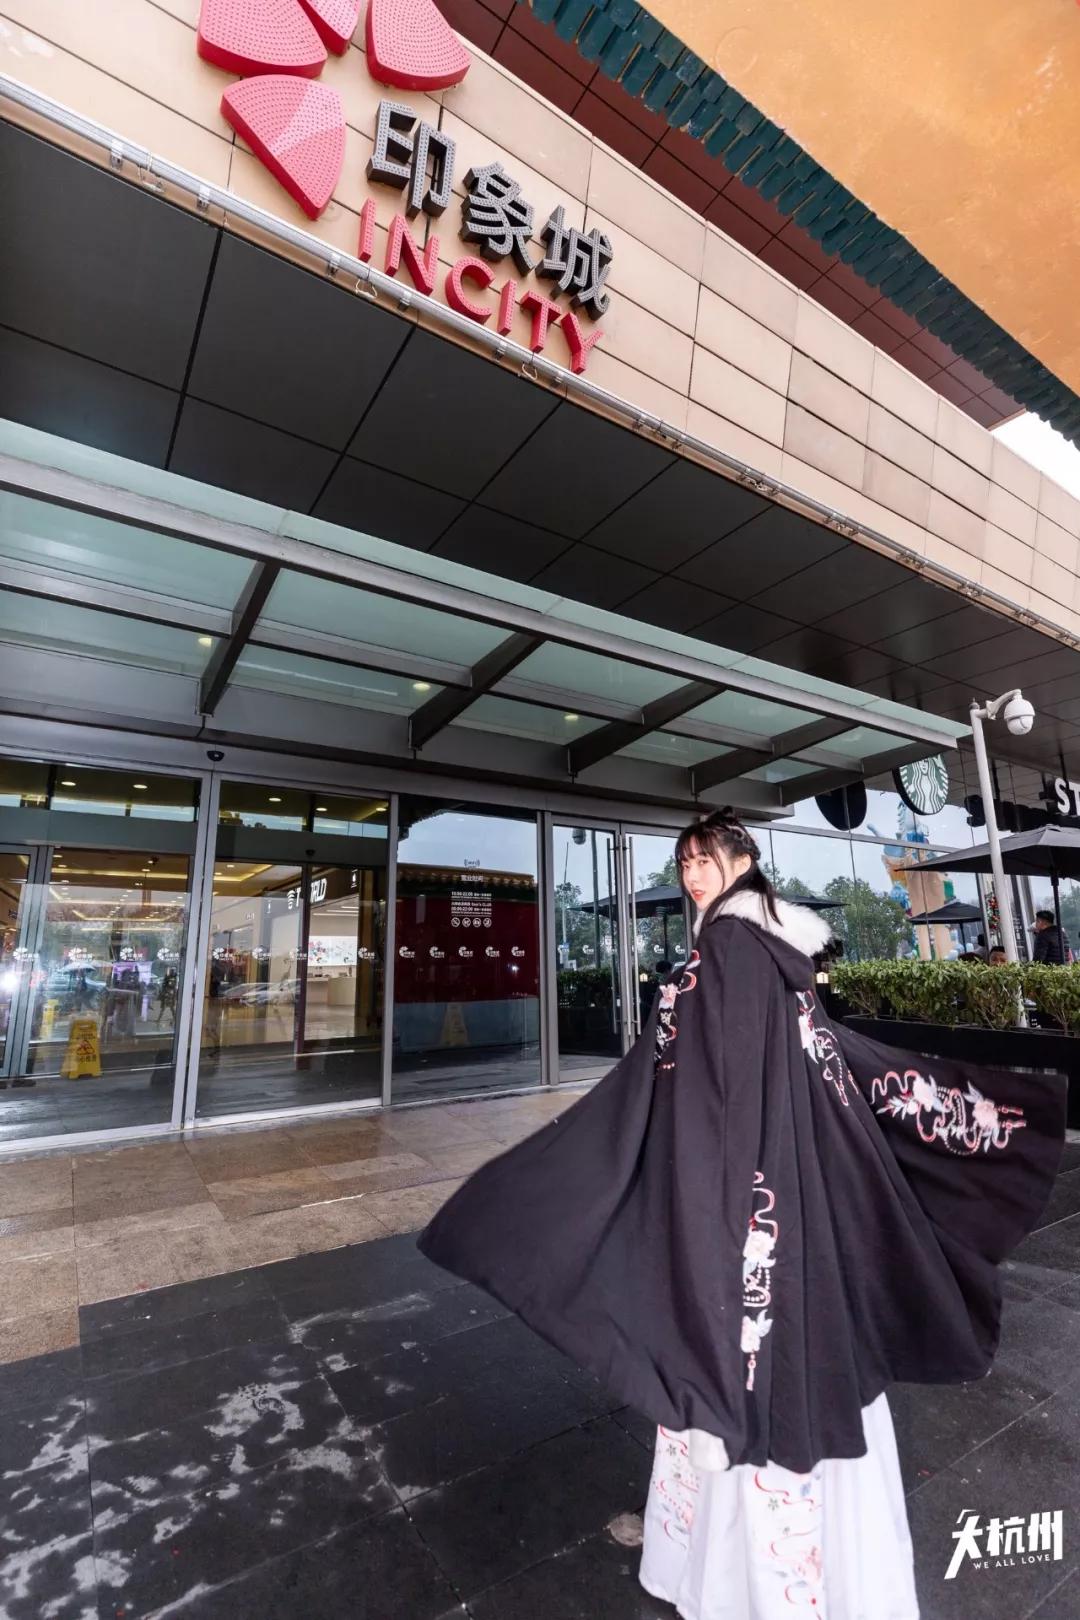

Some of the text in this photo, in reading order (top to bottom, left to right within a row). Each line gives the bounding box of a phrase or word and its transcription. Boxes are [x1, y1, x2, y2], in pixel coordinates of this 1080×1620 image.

[357, 197, 604, 374] INCITY
[365, 100, 614, 320] 印象城
